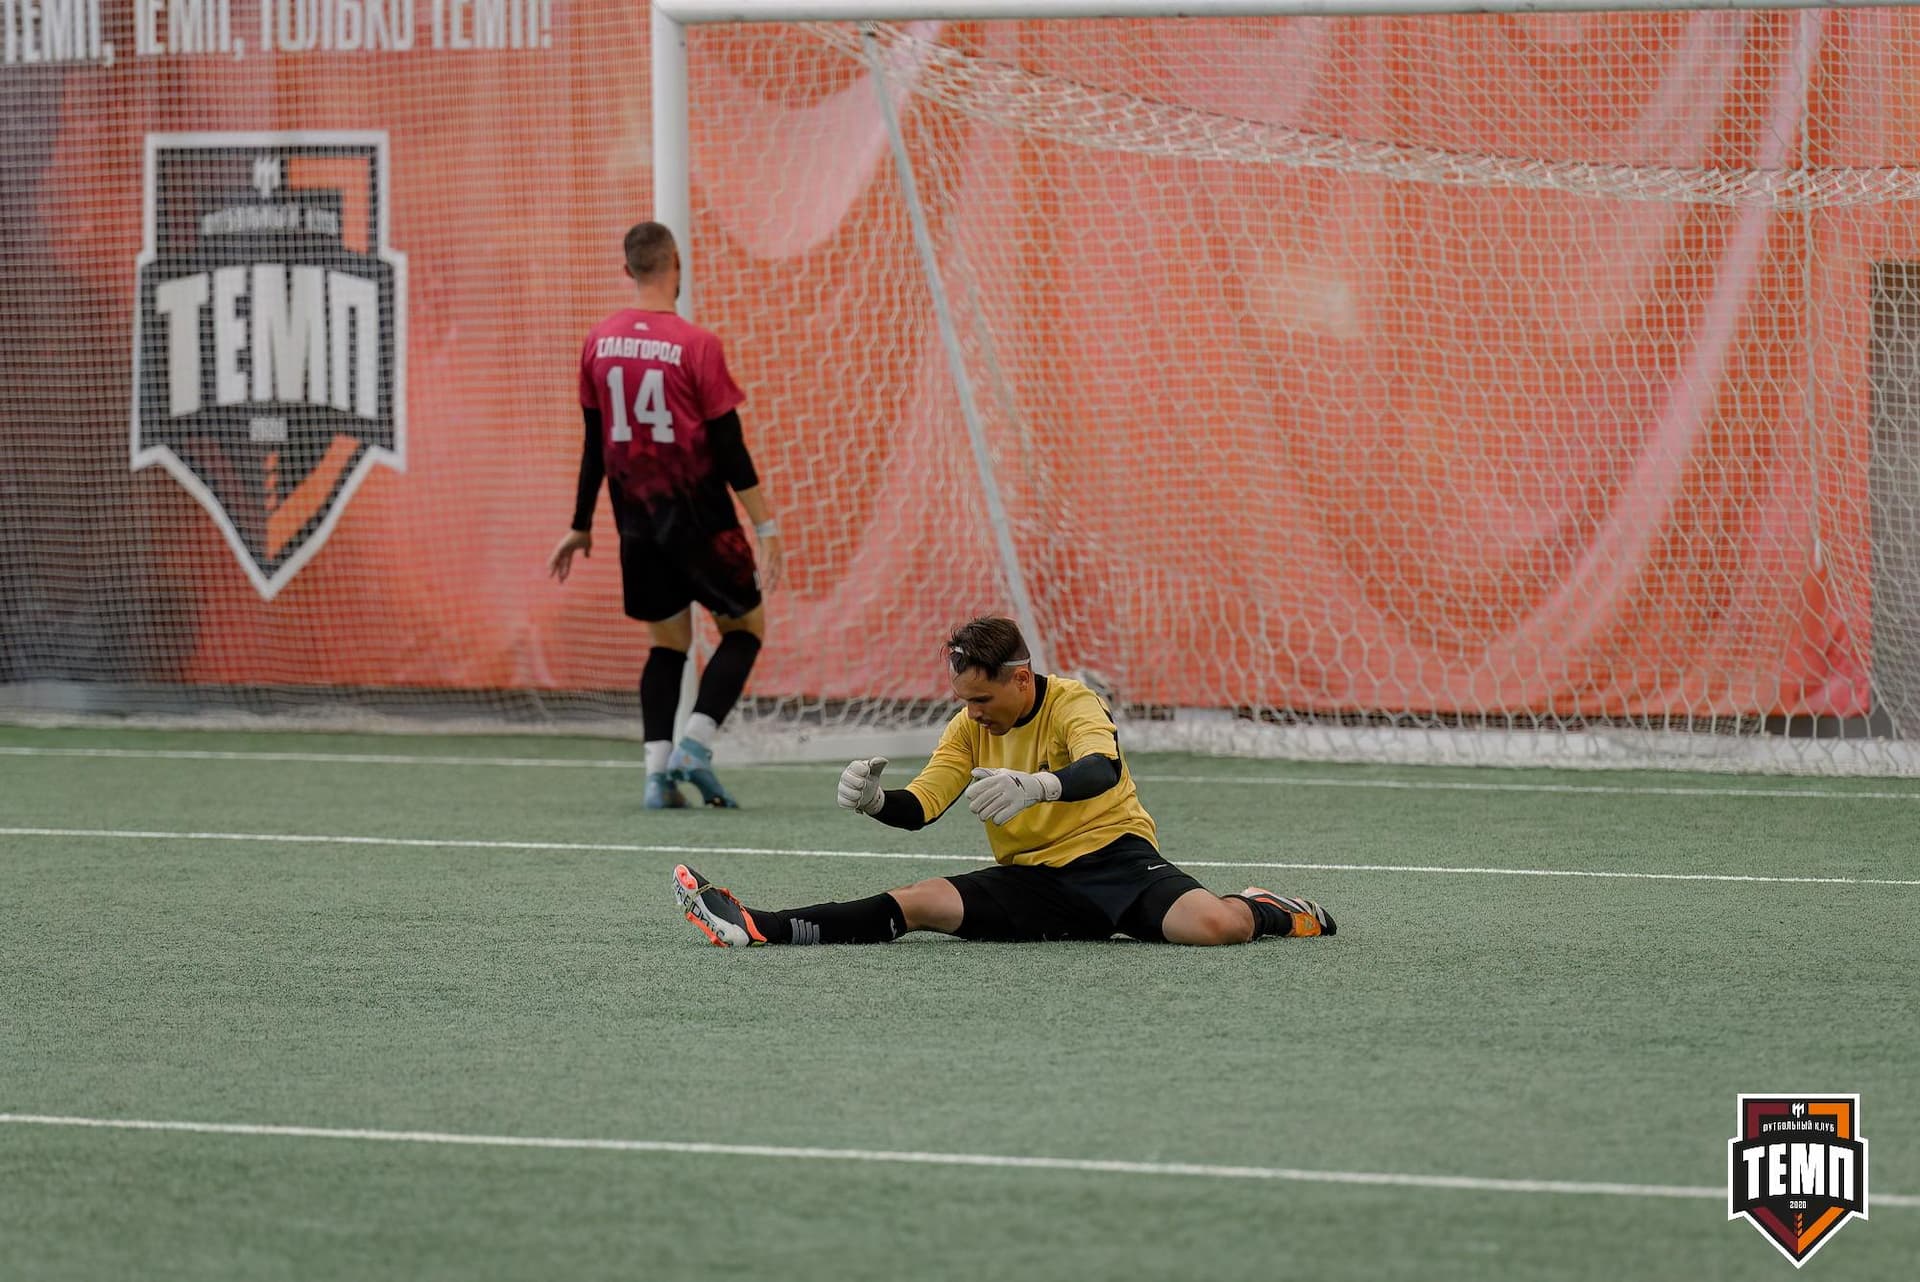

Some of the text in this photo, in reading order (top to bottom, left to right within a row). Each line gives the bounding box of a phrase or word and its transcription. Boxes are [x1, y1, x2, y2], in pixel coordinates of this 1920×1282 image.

[155, 263, 378, 418] ТЕМП
[596, 336, 682, 367] СЛАВГОРОД
[607, 366, 675, 443] 14
